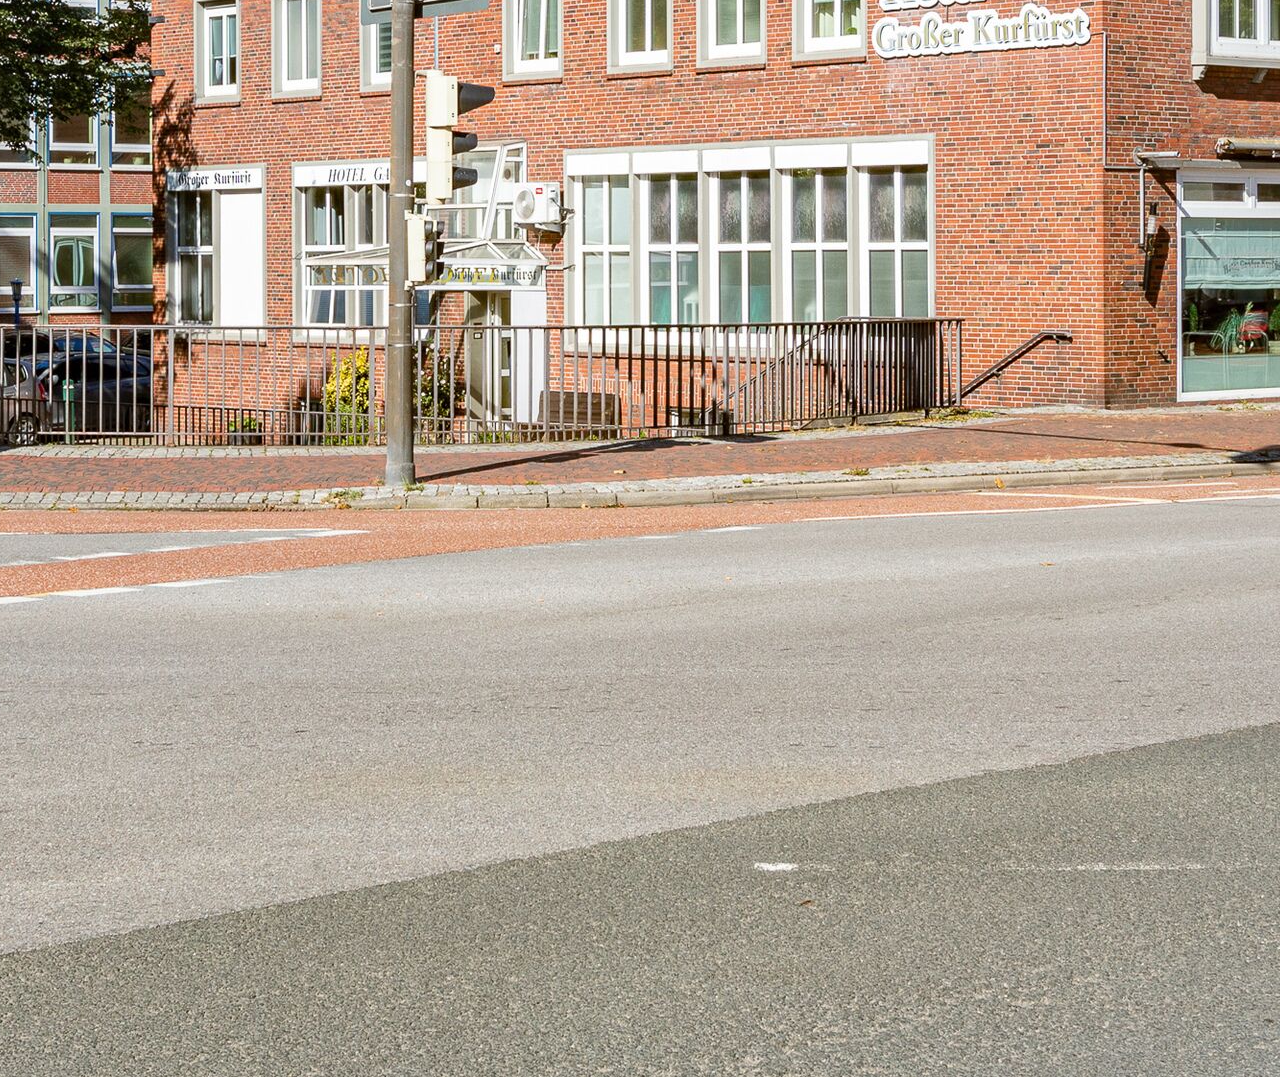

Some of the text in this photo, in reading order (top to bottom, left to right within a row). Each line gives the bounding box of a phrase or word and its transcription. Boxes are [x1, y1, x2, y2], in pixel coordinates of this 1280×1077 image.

[875, 9, 1086, 53] Großer Kurfürst
[328, 167, 367, 182] HOTEL
